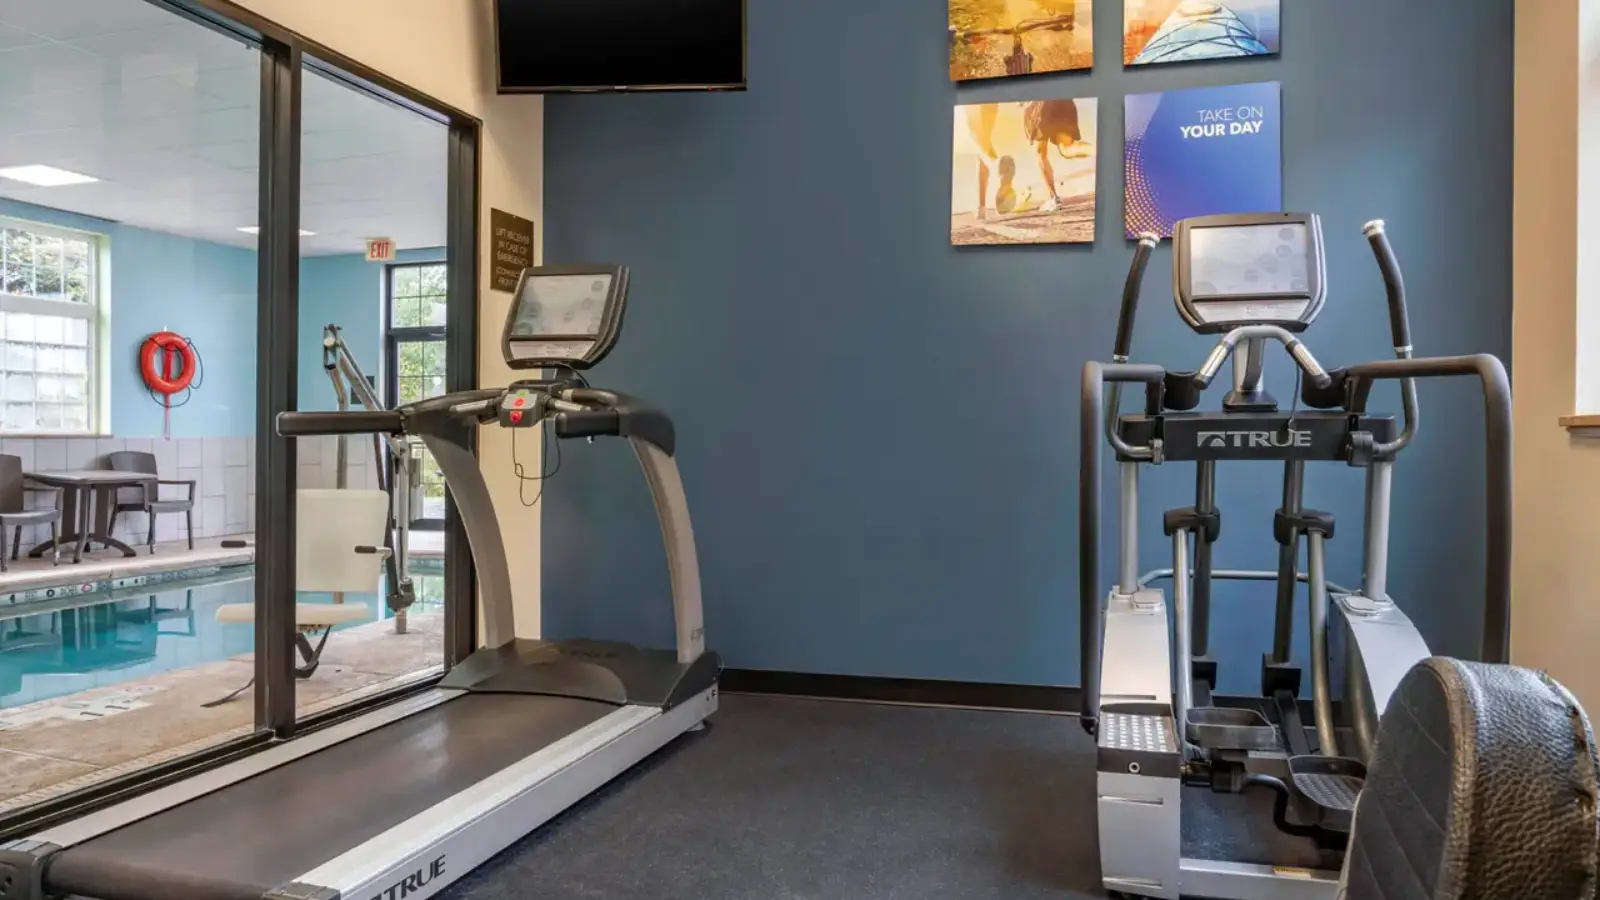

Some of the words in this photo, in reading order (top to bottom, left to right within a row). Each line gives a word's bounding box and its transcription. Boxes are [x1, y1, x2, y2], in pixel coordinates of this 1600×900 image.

[1197, 107, 1233, 122] TAKE
[1237, 105, 1264, 120] ON
[1180, 124, 1226, 139] YOUR
[1229, 120, 1263, 135] DAY
[371, 241, 389, 258] EXIT
[1226, 430, 1311, 447] TRUE
[384, 854, 446, 900] TRUE
